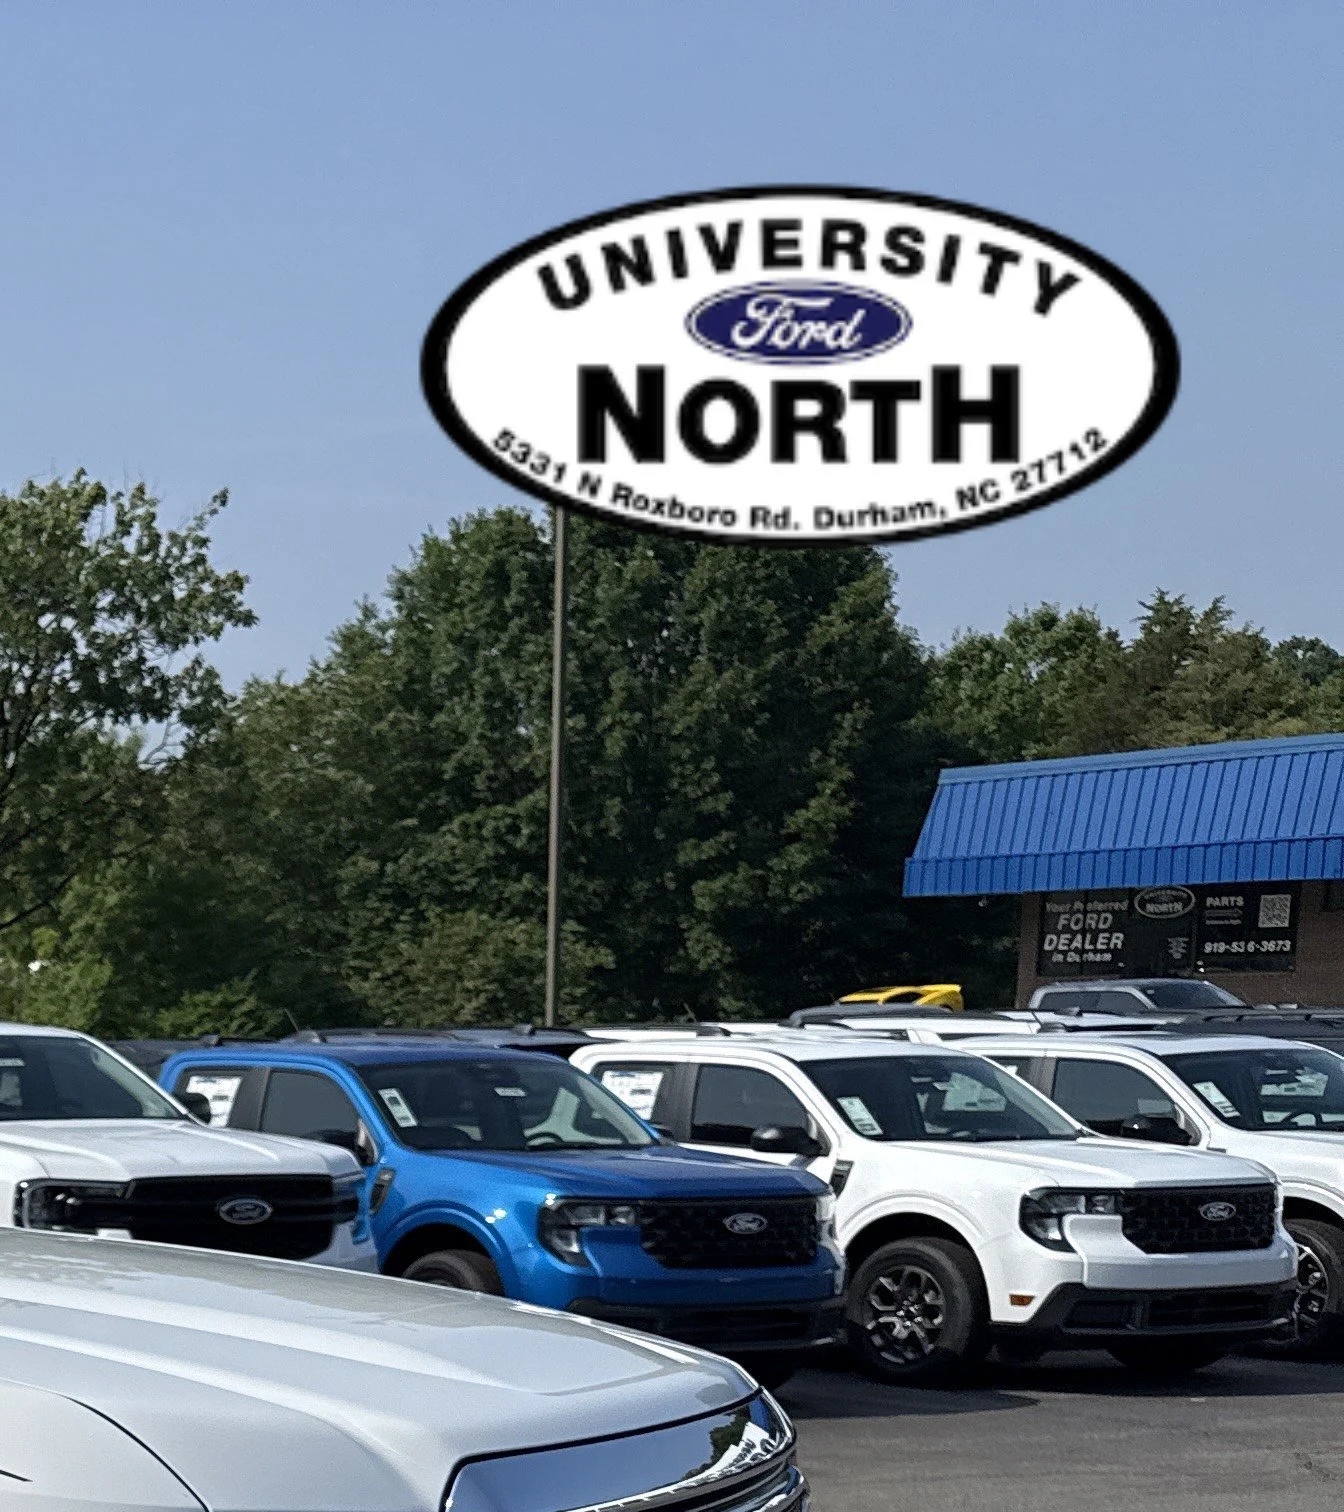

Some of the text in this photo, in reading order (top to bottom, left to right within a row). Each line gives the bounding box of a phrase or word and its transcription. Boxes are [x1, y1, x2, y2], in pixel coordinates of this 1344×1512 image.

[1206, 896, 1244, 907] PARTS
[1057, 912, 1113, 930] FORD
[1043, 932, 1124, 950] DEALER
